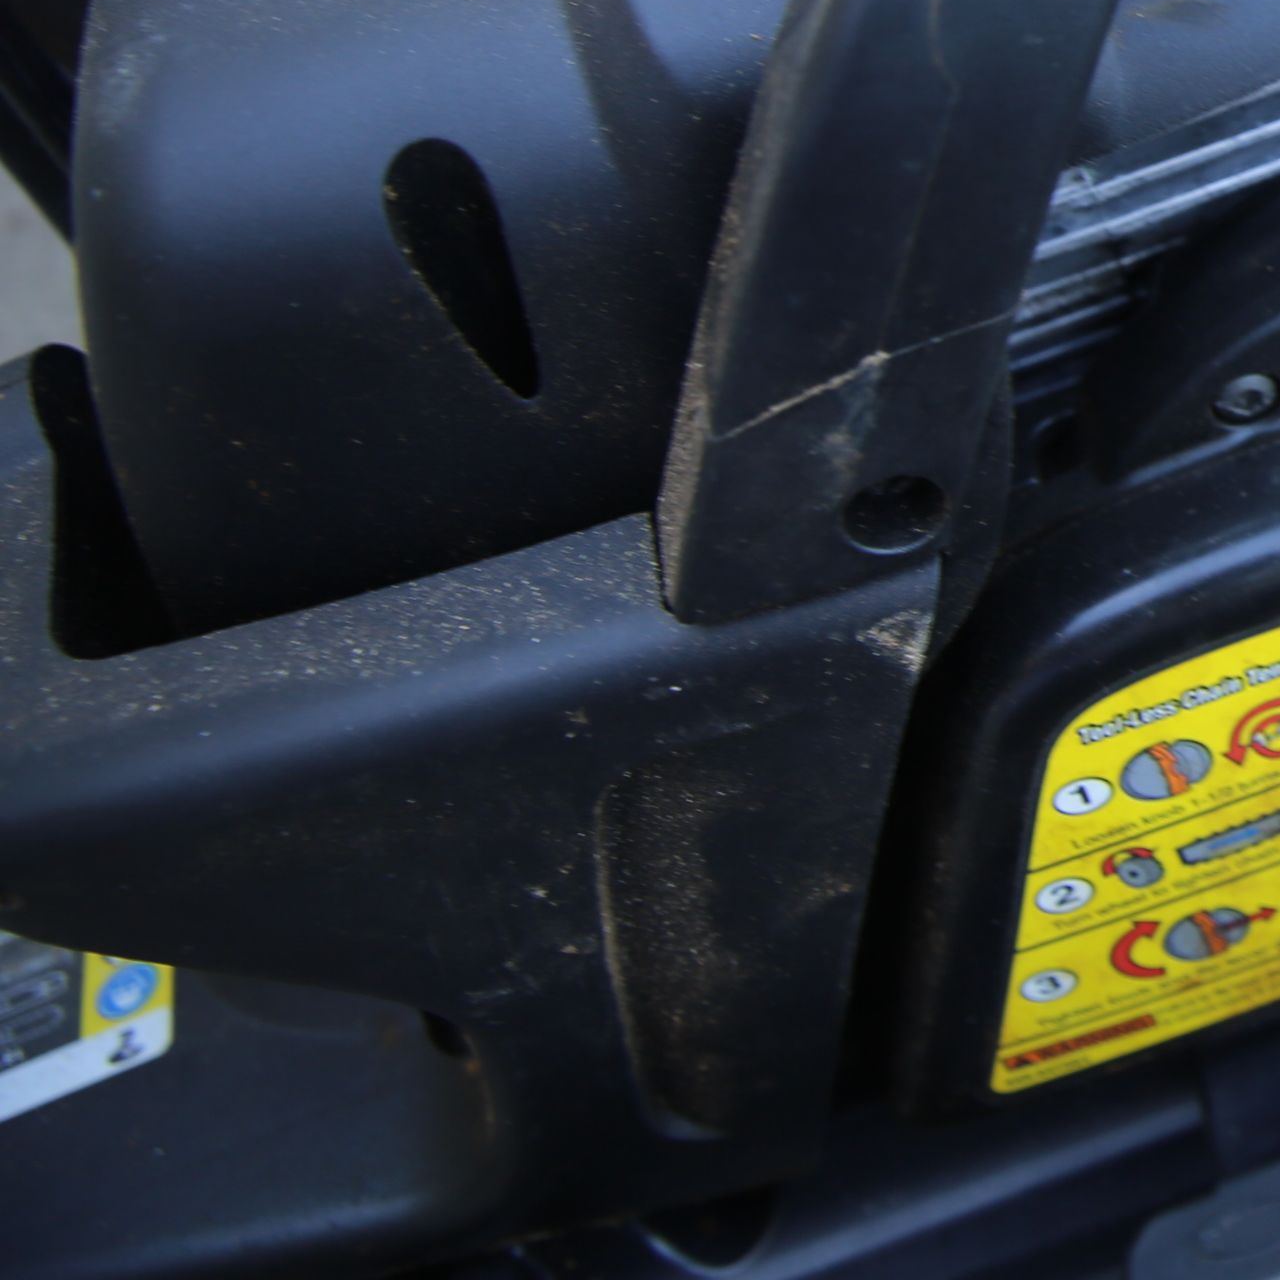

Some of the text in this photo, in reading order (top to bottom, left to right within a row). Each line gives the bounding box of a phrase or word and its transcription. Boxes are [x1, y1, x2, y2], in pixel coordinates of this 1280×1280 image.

[1077, 699, 1181, 746] Tool-Less
[1179, 676, 1245, 710] Chain
[1069, 785, 1091, 805] 1
[1050, 884, 1080, 907] 2
